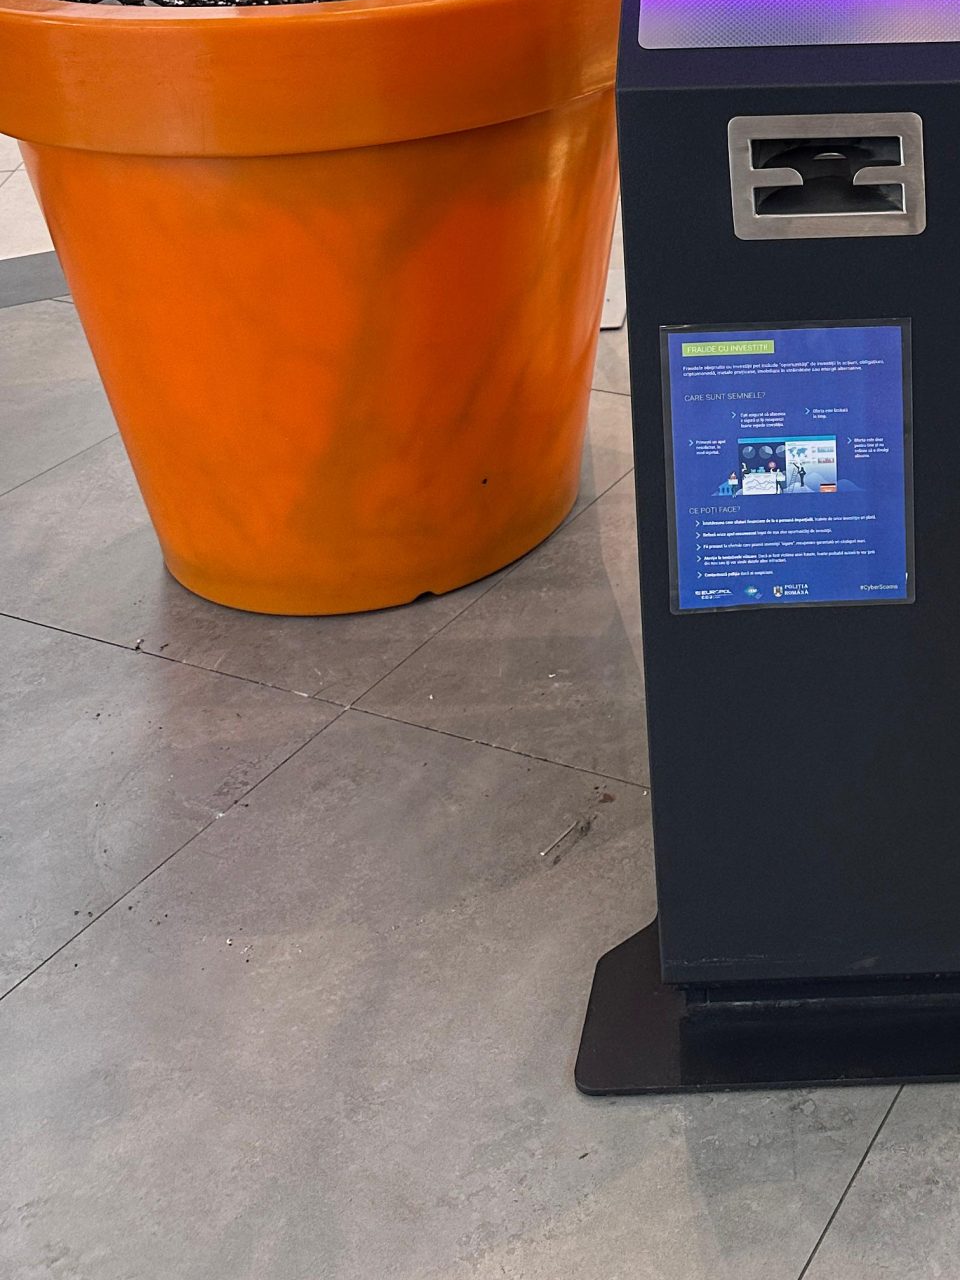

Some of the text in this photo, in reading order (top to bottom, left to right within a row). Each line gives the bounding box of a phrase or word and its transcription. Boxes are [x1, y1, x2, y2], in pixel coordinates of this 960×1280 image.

[687, 345, 716, 353] FRAUDE
[684, 391, 766, 402] CARE SUNT SEMNELE?
[719, 505, 740, 513] FACE?
